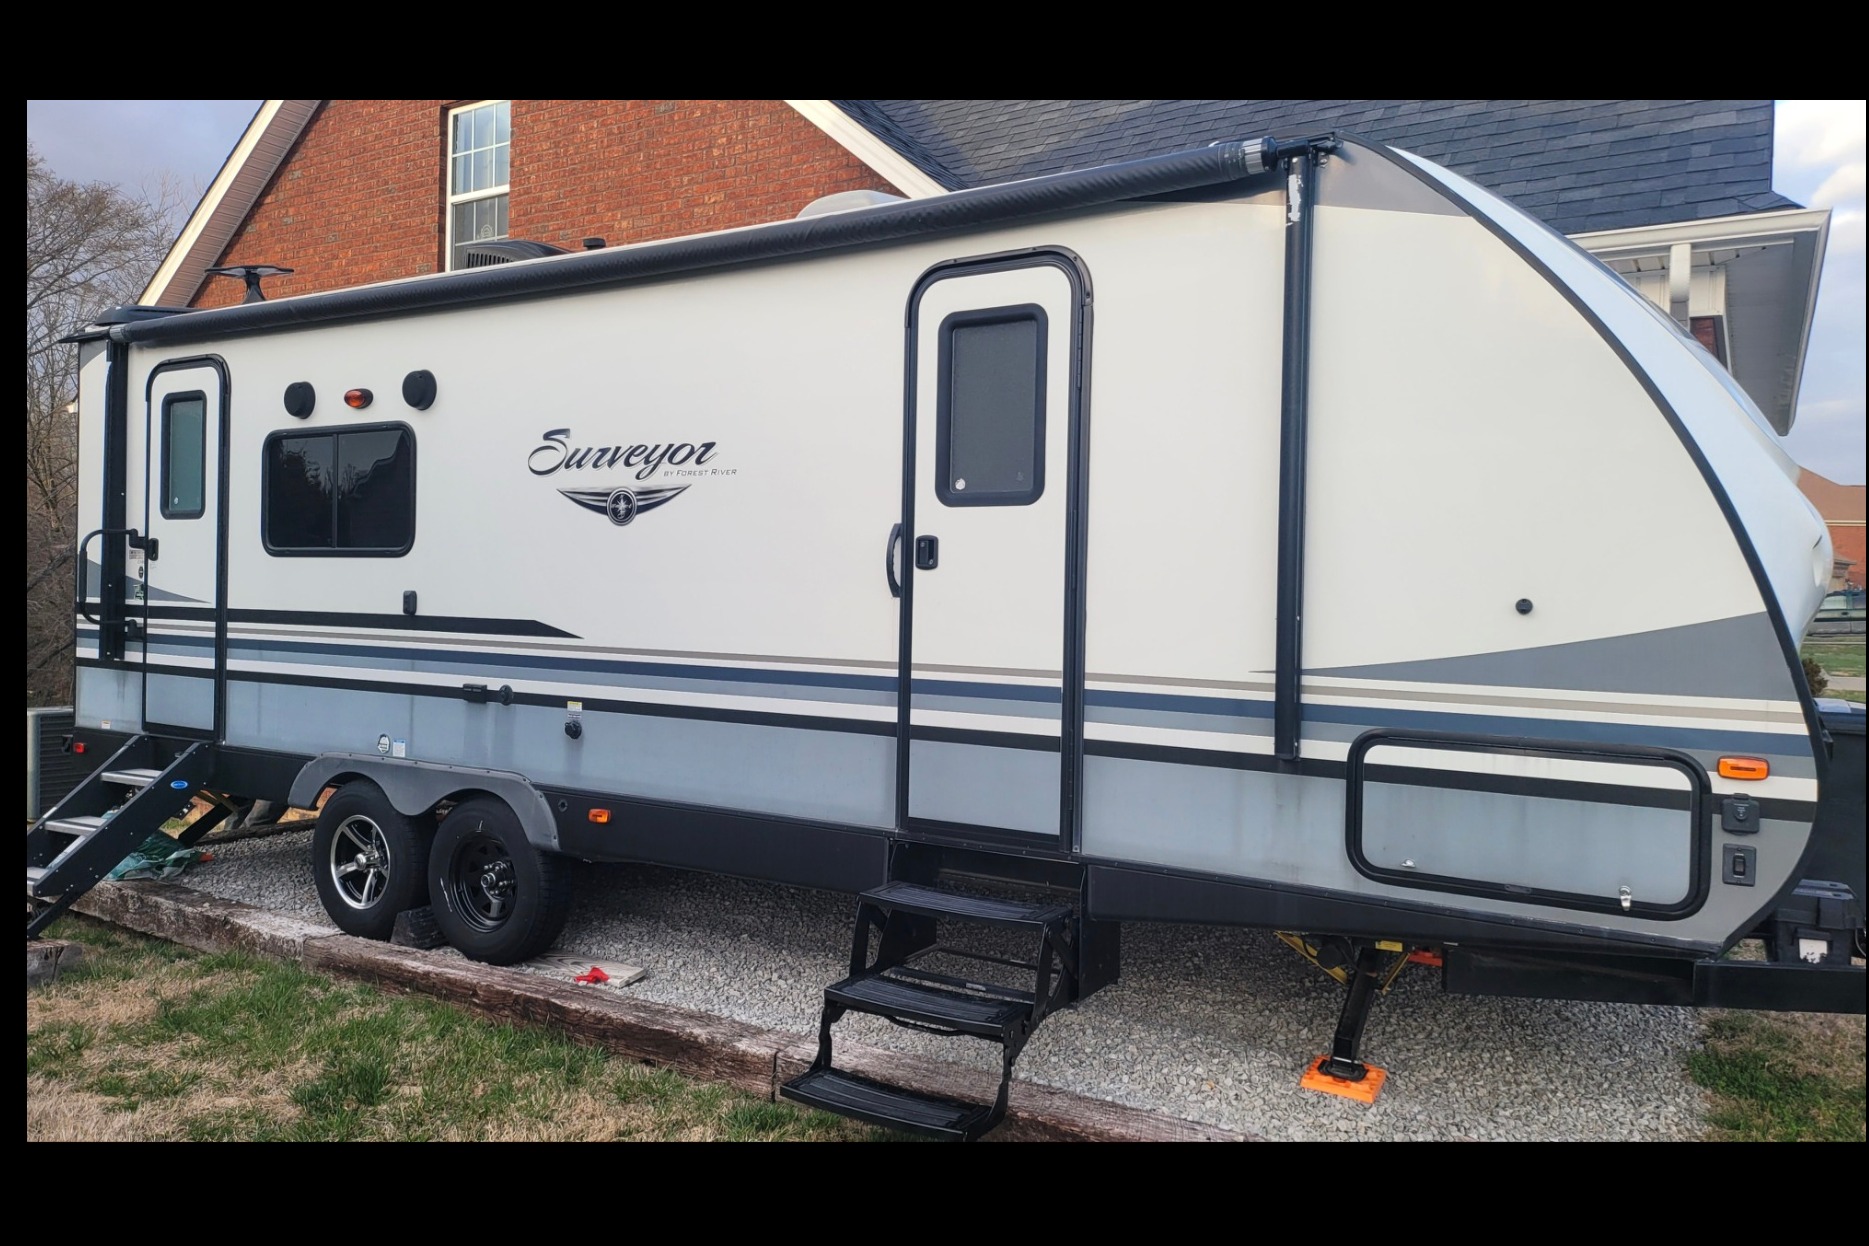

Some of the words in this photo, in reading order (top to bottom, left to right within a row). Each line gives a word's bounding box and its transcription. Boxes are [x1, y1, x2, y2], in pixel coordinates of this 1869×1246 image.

[528, 428, 718, 480] Surveyor
[676, 469, 709, 477] FOREST
[710, 468, 738, 476] RIVER
